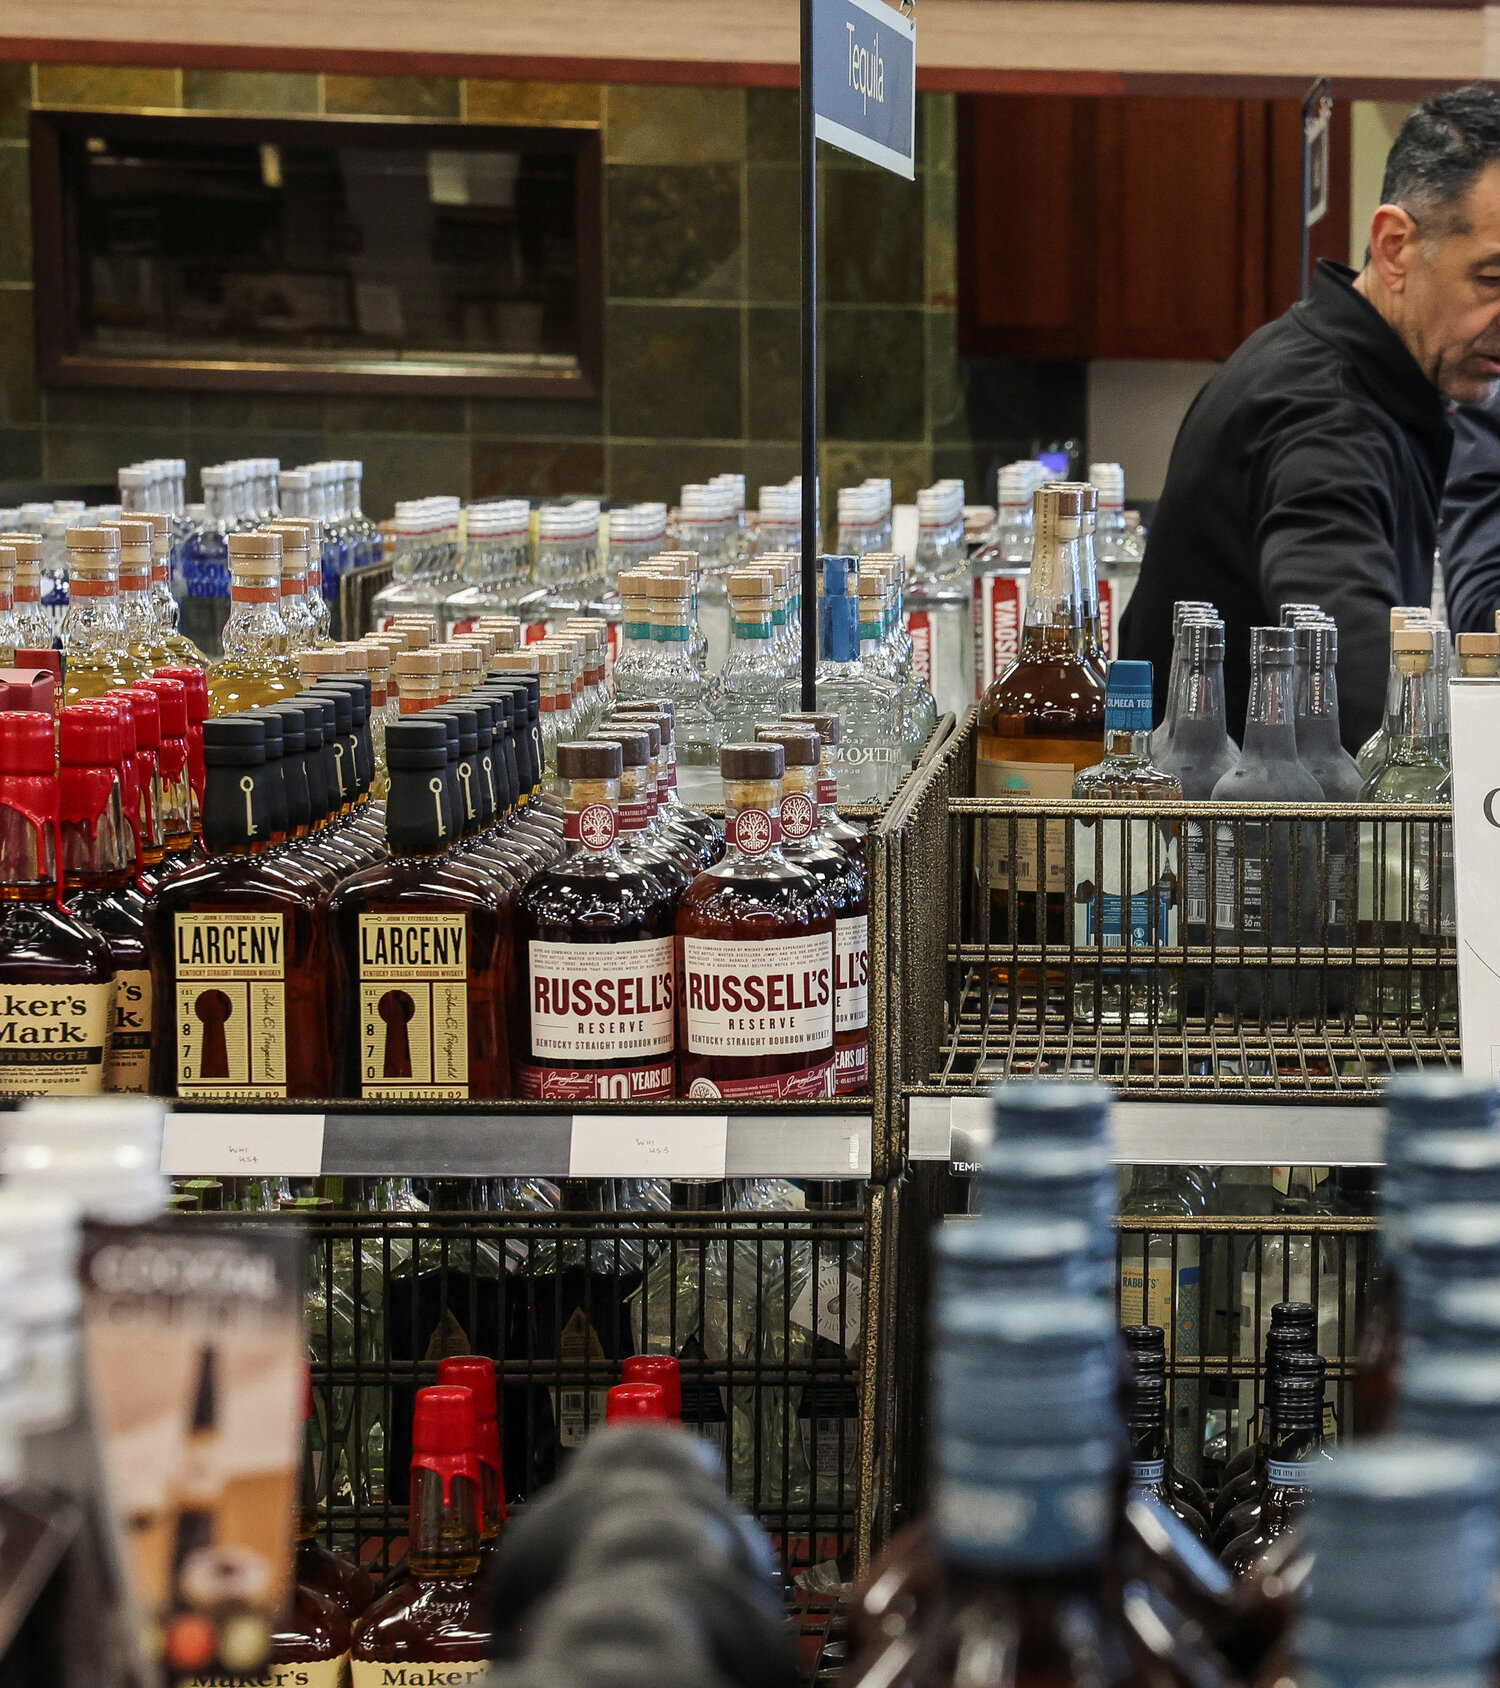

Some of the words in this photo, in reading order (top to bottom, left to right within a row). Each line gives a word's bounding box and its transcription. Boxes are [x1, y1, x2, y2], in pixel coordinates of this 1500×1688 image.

[845, 21, 884, 116] Tequila
[178, 926, 280, 964] LARCENY
[362, 927, 463, 964] LARCENY
[534, 972, 673, 1017] RUSSELL'S
[689, 968, 830, 1013] RUSSELL'S
[0, 995, 87, 1017] ker's
[578, 1020, 644, 1034] RESERVE
[729, 1017, 796, 1030] RESERVE
[536, 1038, 572, 1050] KENTUCKY
[575, 1041, 615, 1050] STRAIGHT
[618, 1039, 650, 1049] BOURBON
[692, 1034, 723, 1046] KENTUCKY
[726, 1037, 766, 1046] STRAIGHT
[769, 1034, 805, 1045] BOURBON
[806, 1030, 830, 1042] WHISKEY
[835, 1051, 854, 1069] EARS
[632, 1068, 661, 1091] YEARS
[1122, 1277, 1157, 1288] RABBS
[382, 1667, 488, 1687] Maker'
